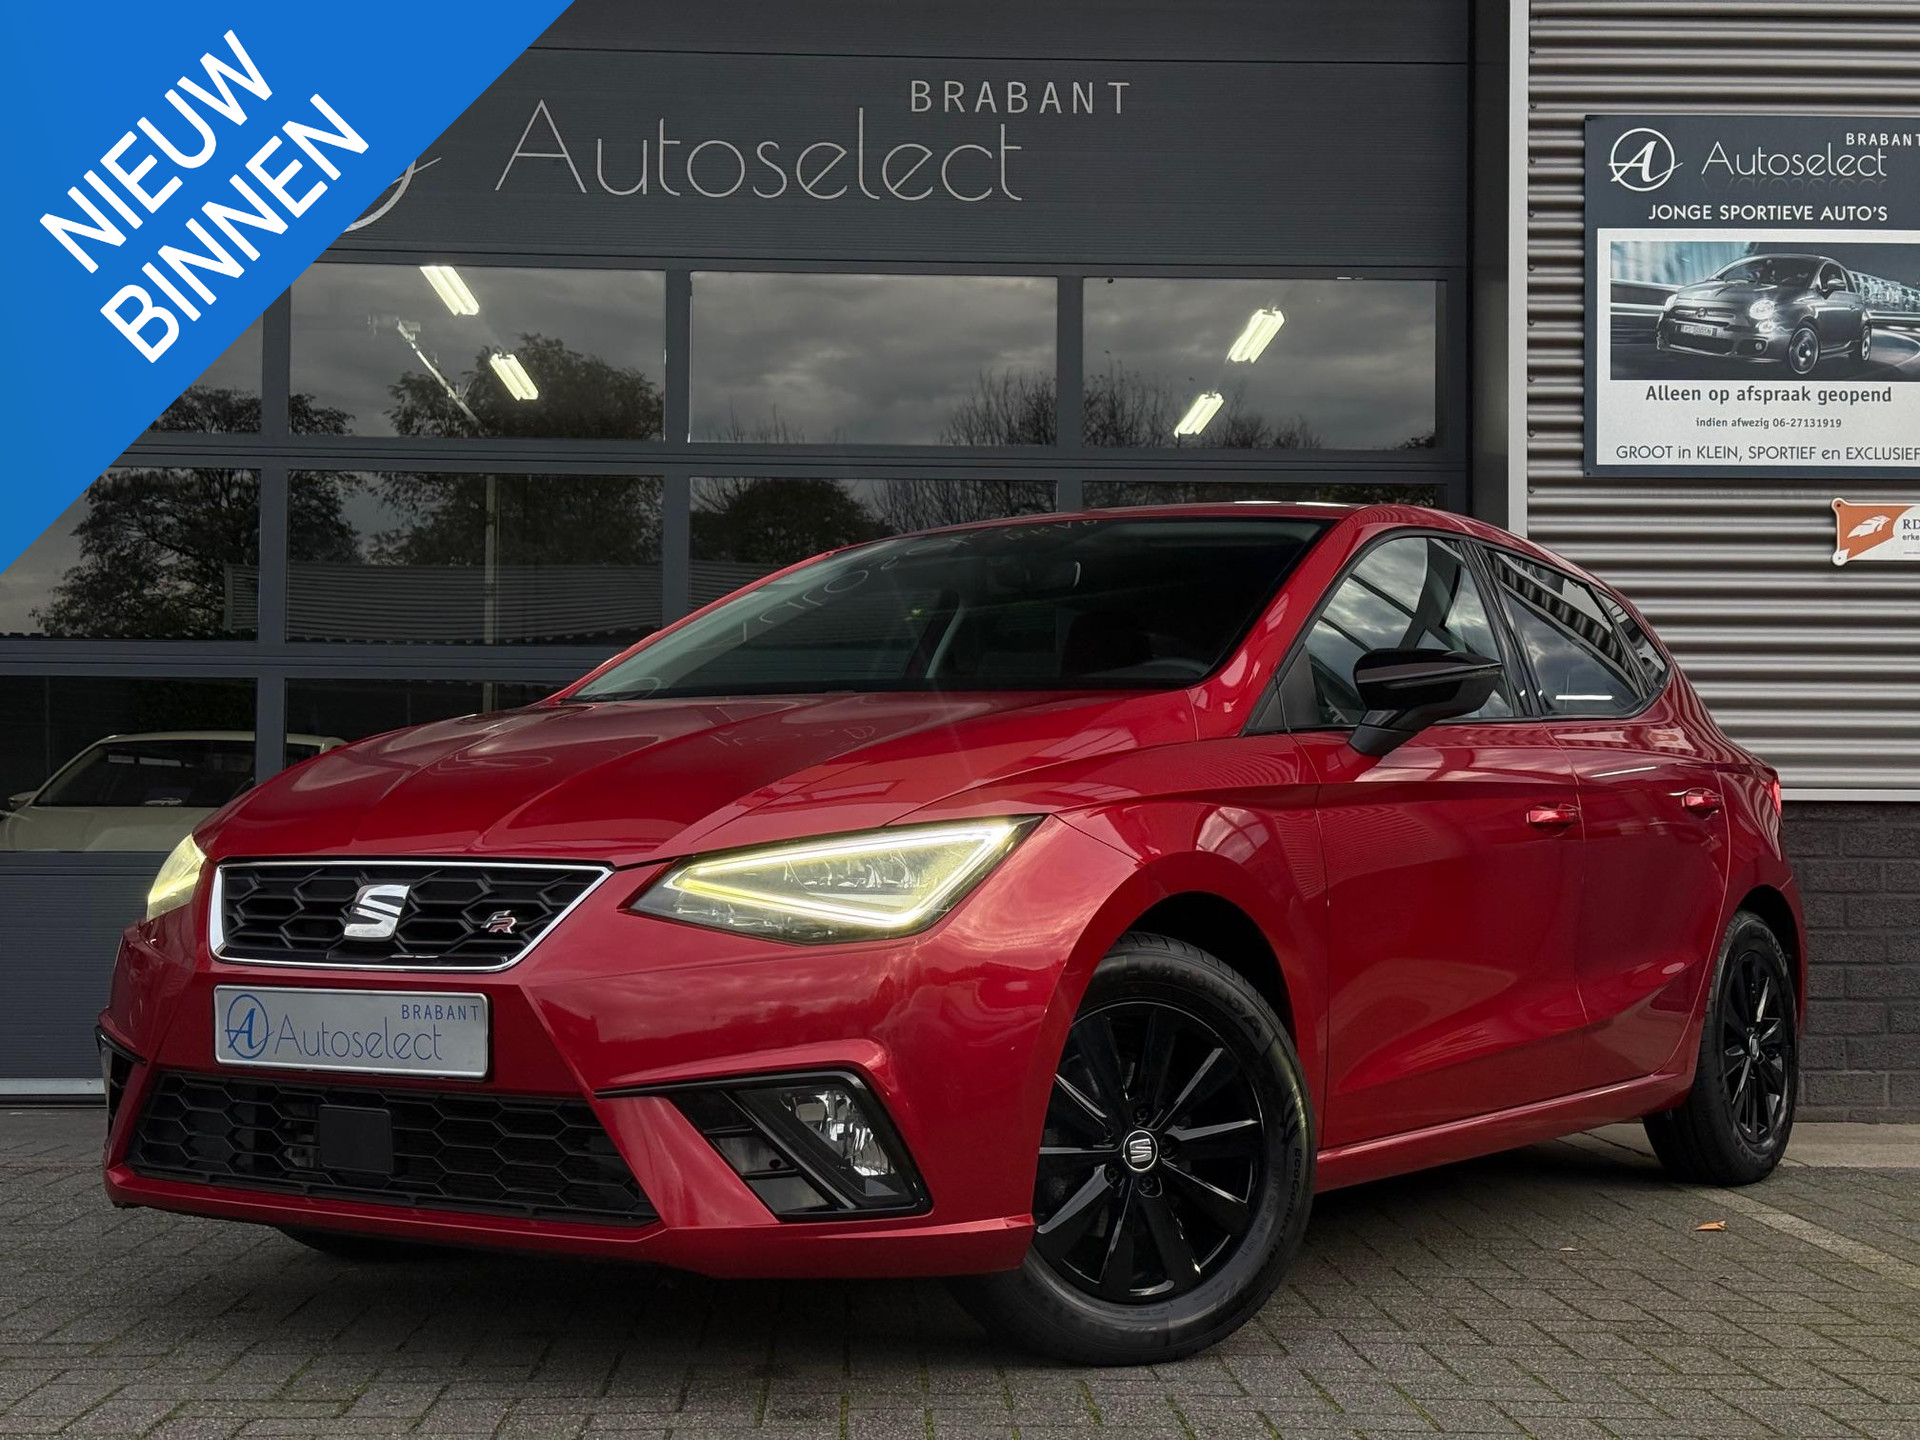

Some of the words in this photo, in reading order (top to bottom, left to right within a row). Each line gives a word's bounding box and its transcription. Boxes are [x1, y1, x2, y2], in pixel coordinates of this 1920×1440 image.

[910, 79, 1130, 115] BRABANT
[494, 99, 1023, 202] Autoselect
[1701, 140, 1887, 177] Autoselect
[1648, 204, 1713, 221] JONGE
[1719, 204, 1815, 221] SPORTIEVE
[1820, 205, 1888, 222] AUTO'S
[1646, 385, 1701, 402] Alleen
[1708, 388, 1730, 405] op
[1736, 386, 1811, 405] afspraak
[1817, 387, 1892, 405] geopend
[1696, 417, 1728, 427] indien
[1731, 417, 1770, 430] afwezig
[1772, 418, 1842, 429] 06-27131919
[1616, 445, 1673, 460] GROOT
[1678, 446, 1691, 459] in
[1696, 446, 1743, 462] KLEIN,
[1748, 446, 1816, 460] SPORTIEF
[1822, 449, 1841, 461] en
[1846, 447, 1920, 461] EXCLUSIEF
[401, 1004, 480, 1021] BRABANT
[274, 1014, 443, 1062] Autoselect
